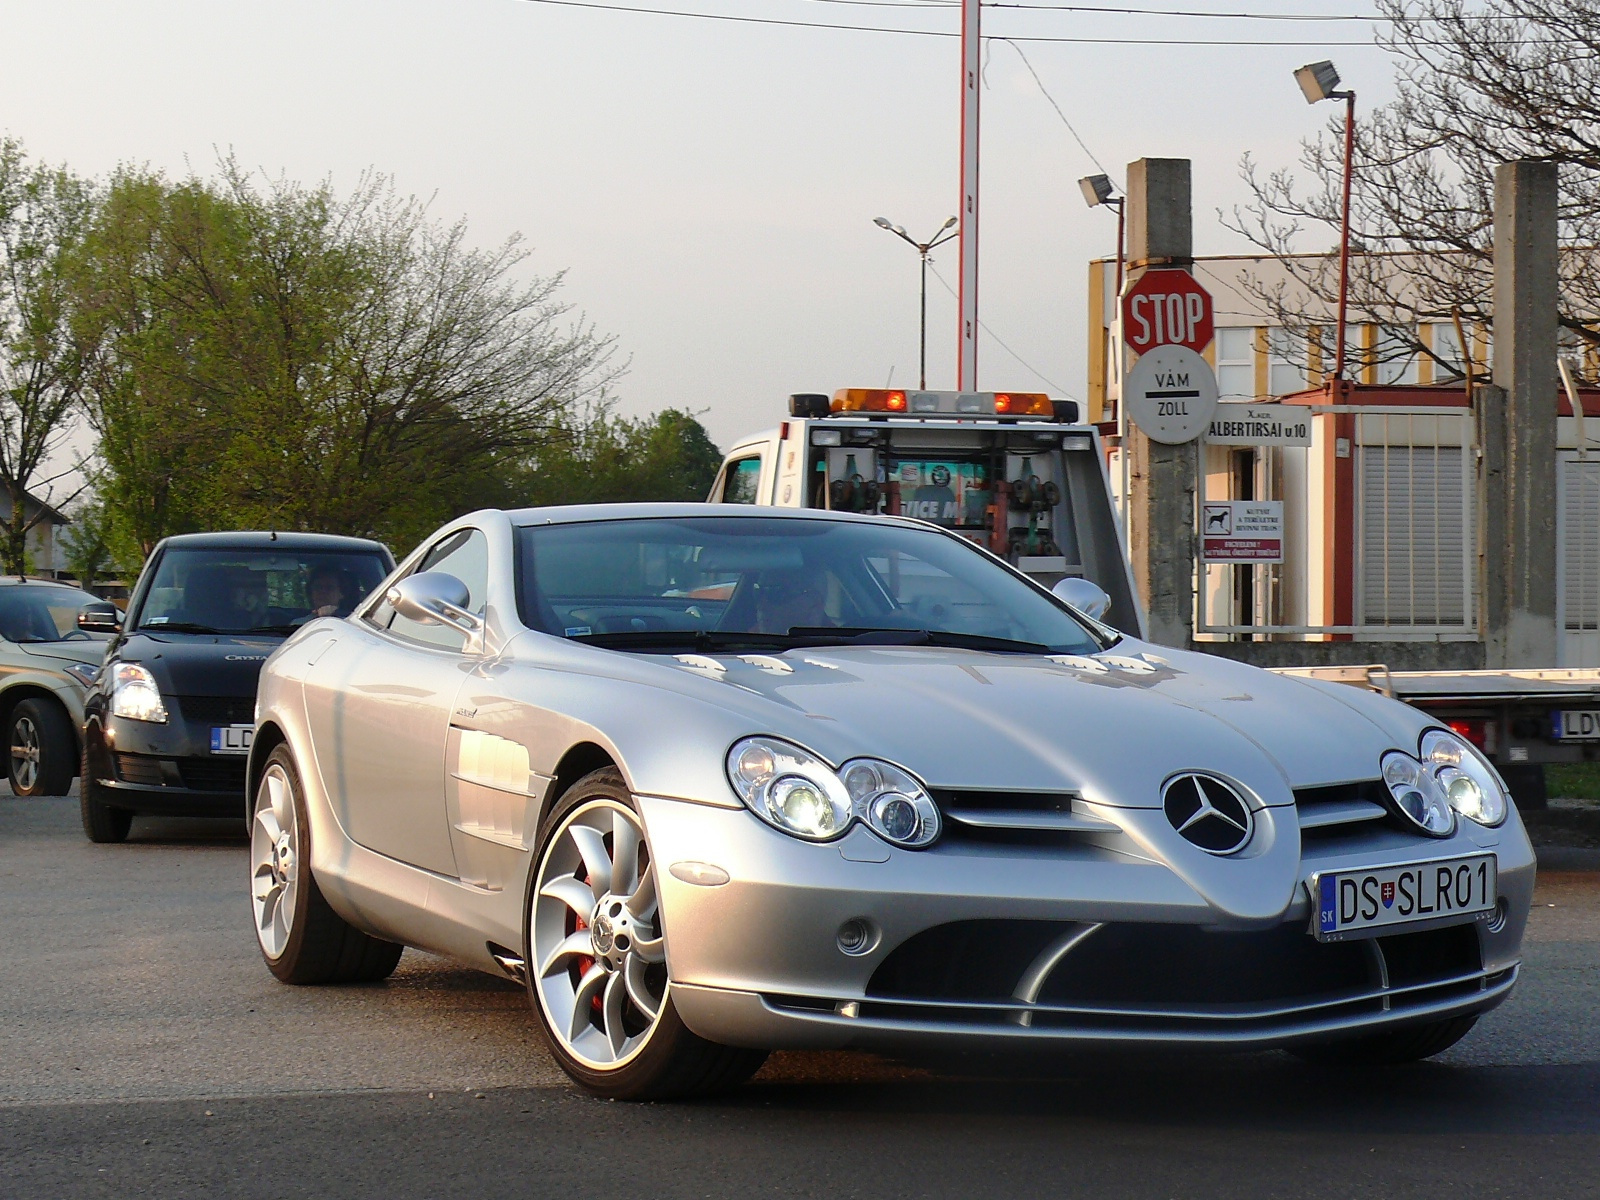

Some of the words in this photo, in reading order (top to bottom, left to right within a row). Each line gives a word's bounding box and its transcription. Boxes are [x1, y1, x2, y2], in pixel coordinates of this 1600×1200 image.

[1131, 292, 1204, 345] STOP
[1155, 369, 1190, 387] VÁM
[1158, 402, 1189, 416] ZOLL
[1209, 422, 1281, 437] ALBERTIRSAI
[1321, 910, 1334, 923] SK
[1340, 876, 1379, 924] DS
[1398, 862, 1487, 916] SLR01
